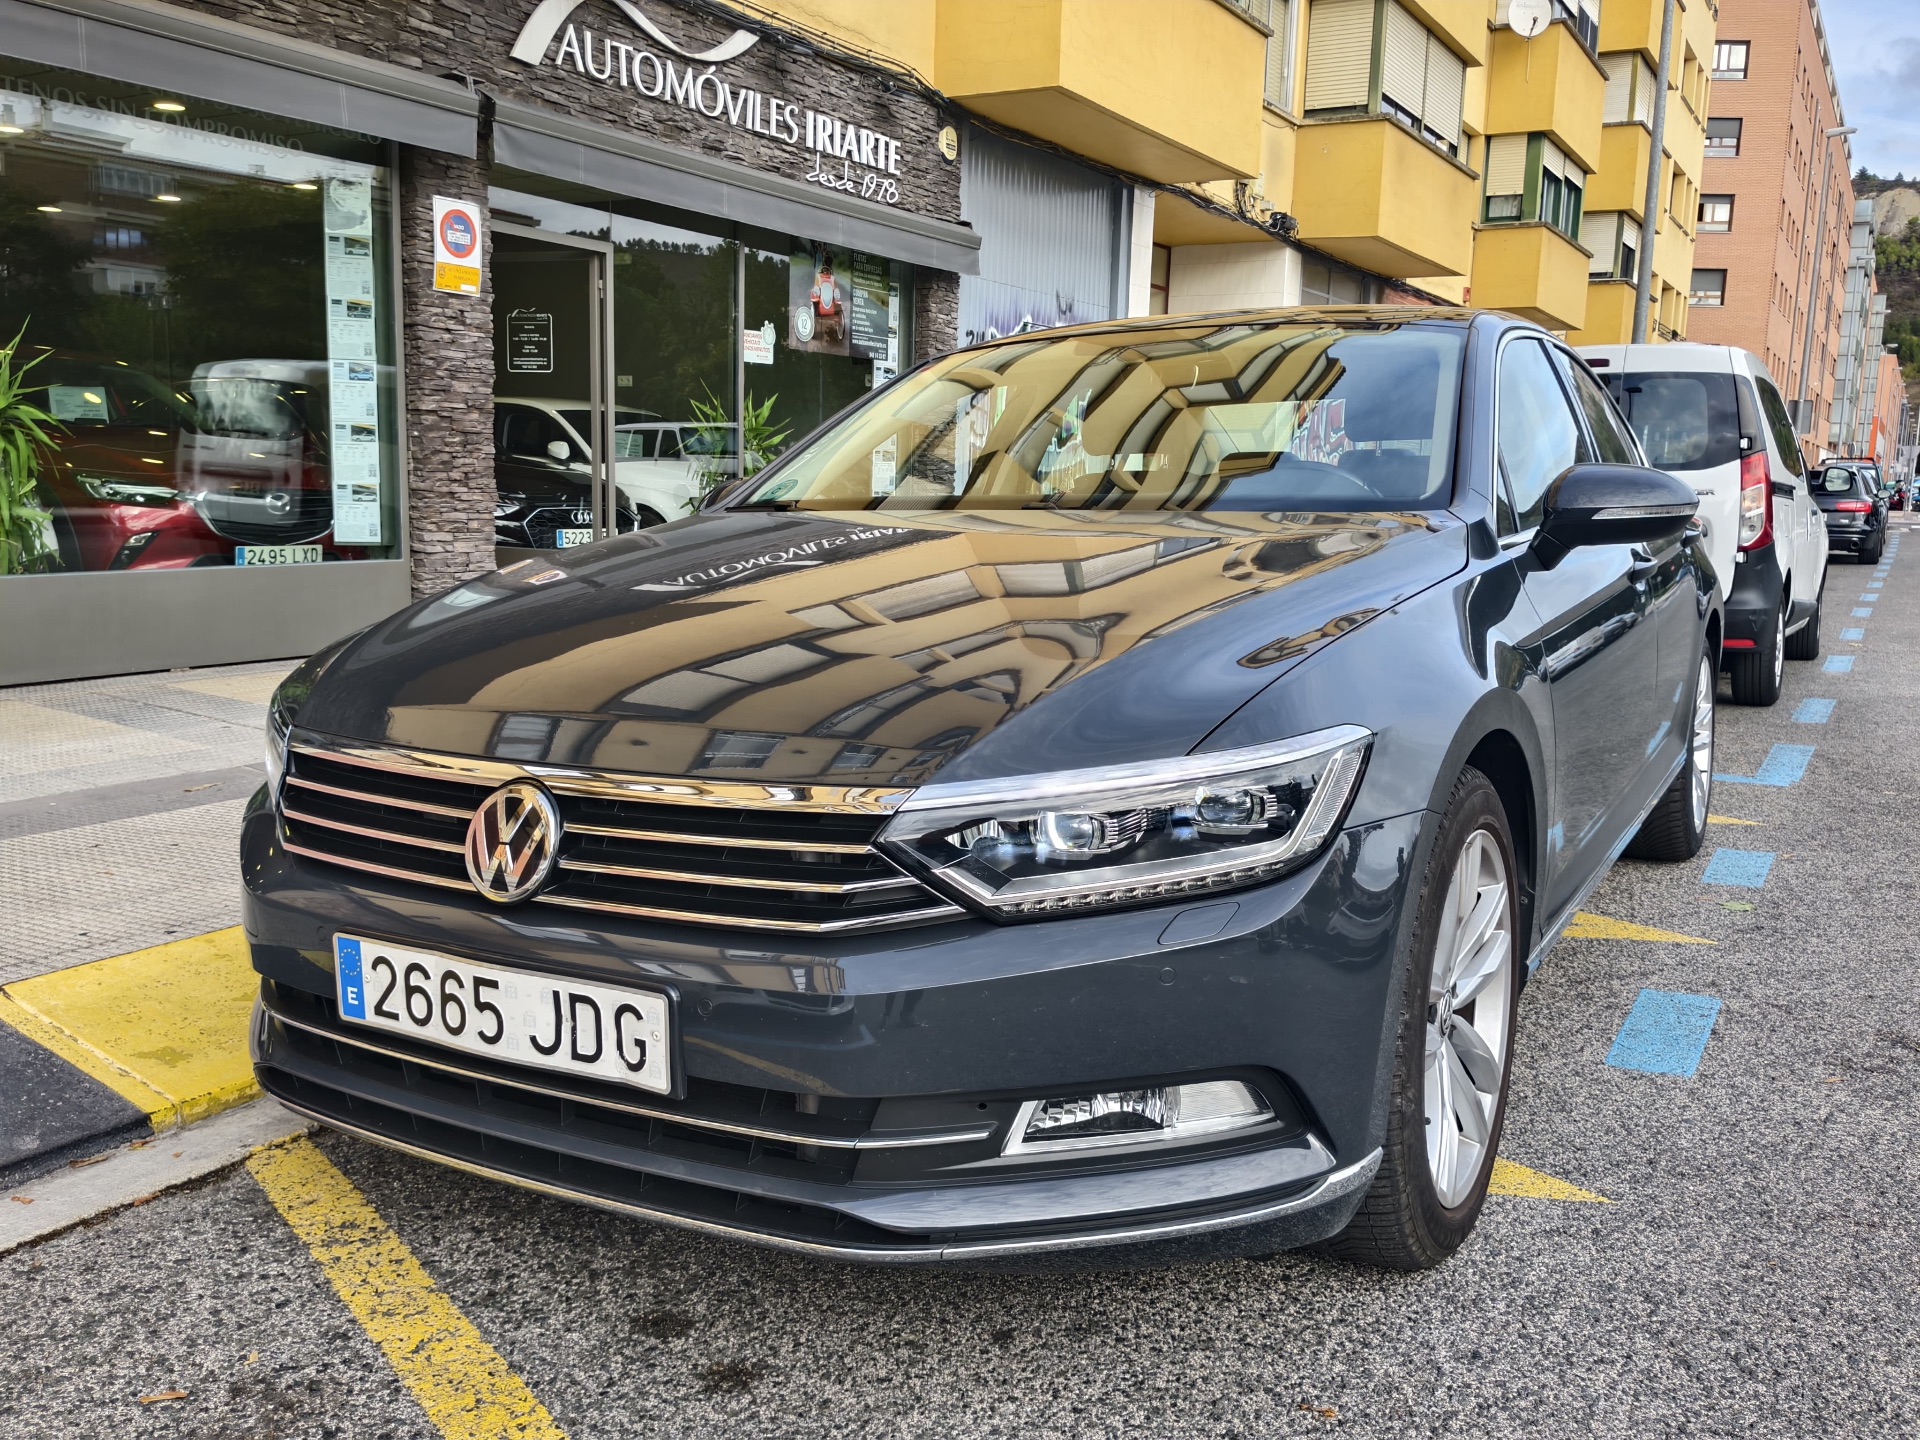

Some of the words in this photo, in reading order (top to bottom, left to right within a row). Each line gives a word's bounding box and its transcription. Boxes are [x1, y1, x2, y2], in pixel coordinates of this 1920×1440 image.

[555, 23, 799, 144] AUTOMÓVILES
[805, 110, 901, 175] IRIARTE
[806, 153, 856, 194] desde
[861, 173, 900, 204] 1978
[247, 548, 287, 565] 2495
[292, 547, 319, 563] LXD
[564, 531, 592, 545] 5223
[347, 986, 359, 1005] E
[371, 954, 504, 1046] 2665
[529, 989, 648, 1073] JDG
